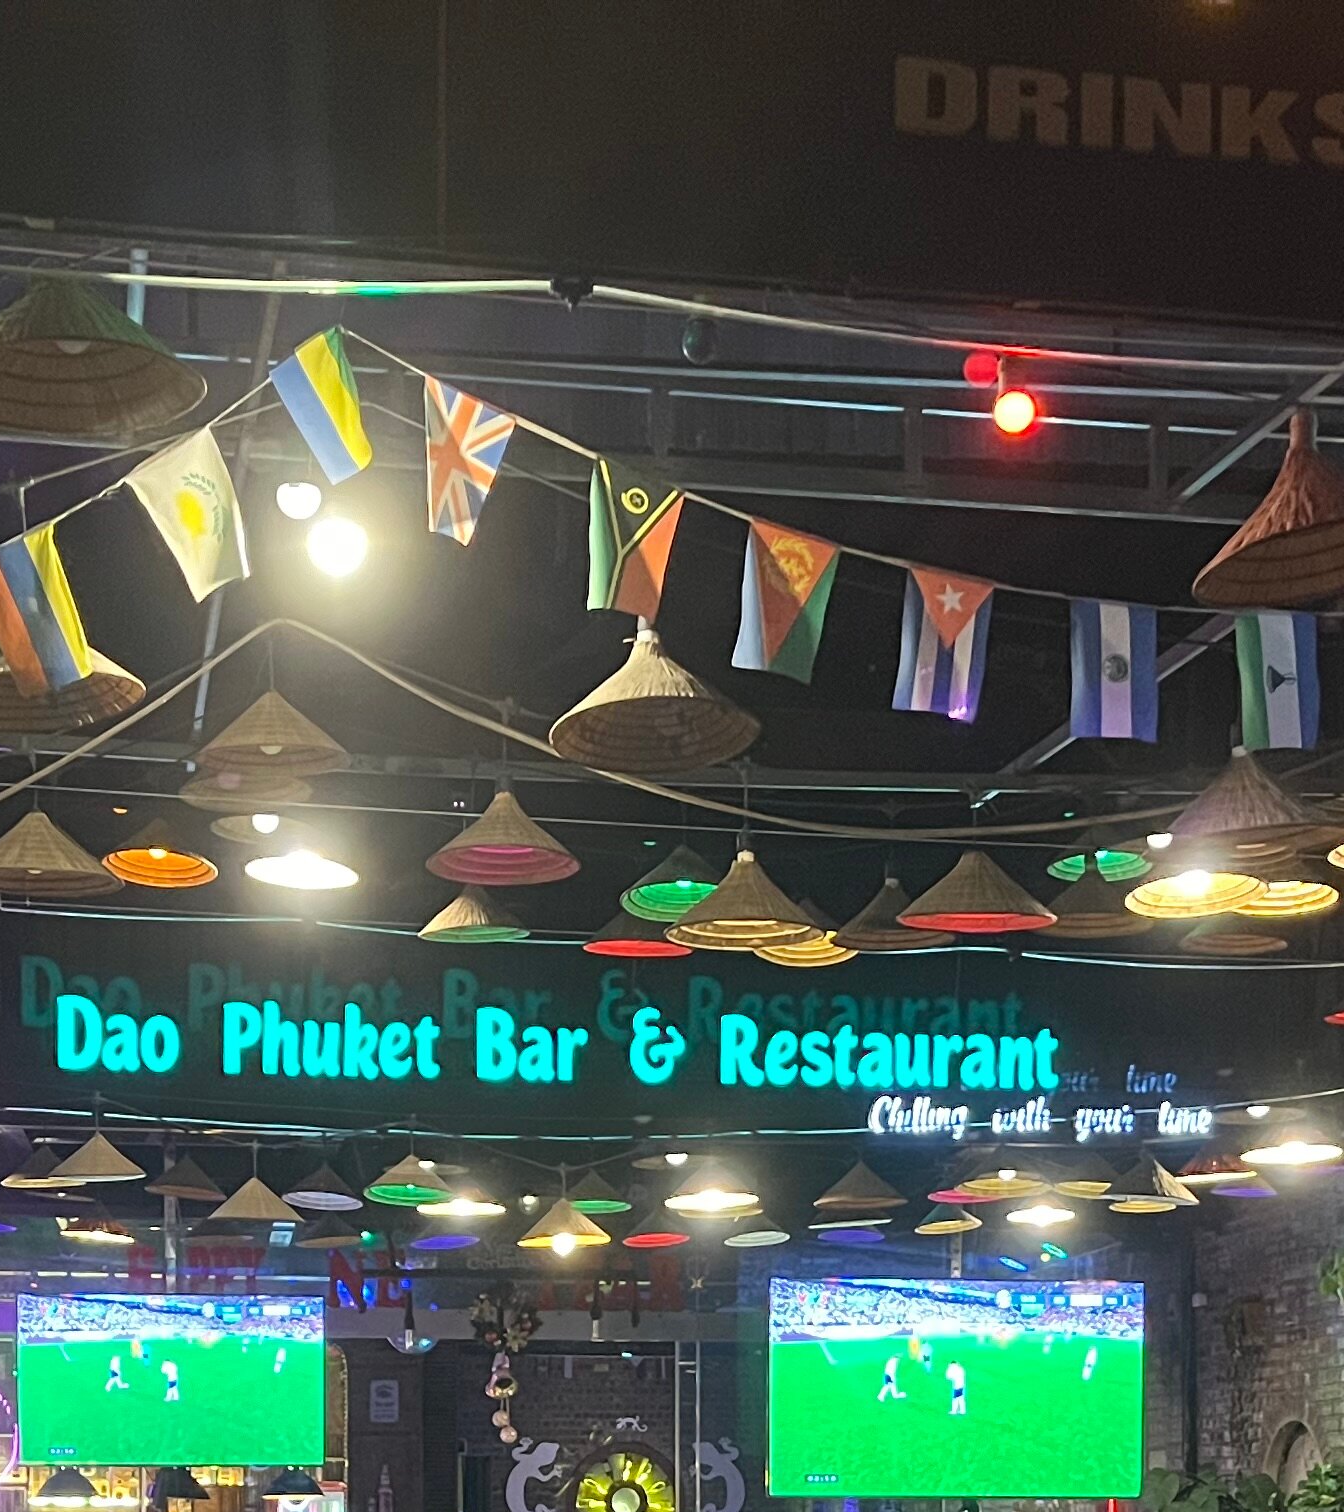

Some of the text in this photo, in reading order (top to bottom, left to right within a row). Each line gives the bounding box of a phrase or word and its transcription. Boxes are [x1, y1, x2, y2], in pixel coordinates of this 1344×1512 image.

[55, 993, 1061, 1090] Dao Phuket Bar & Restaurant
